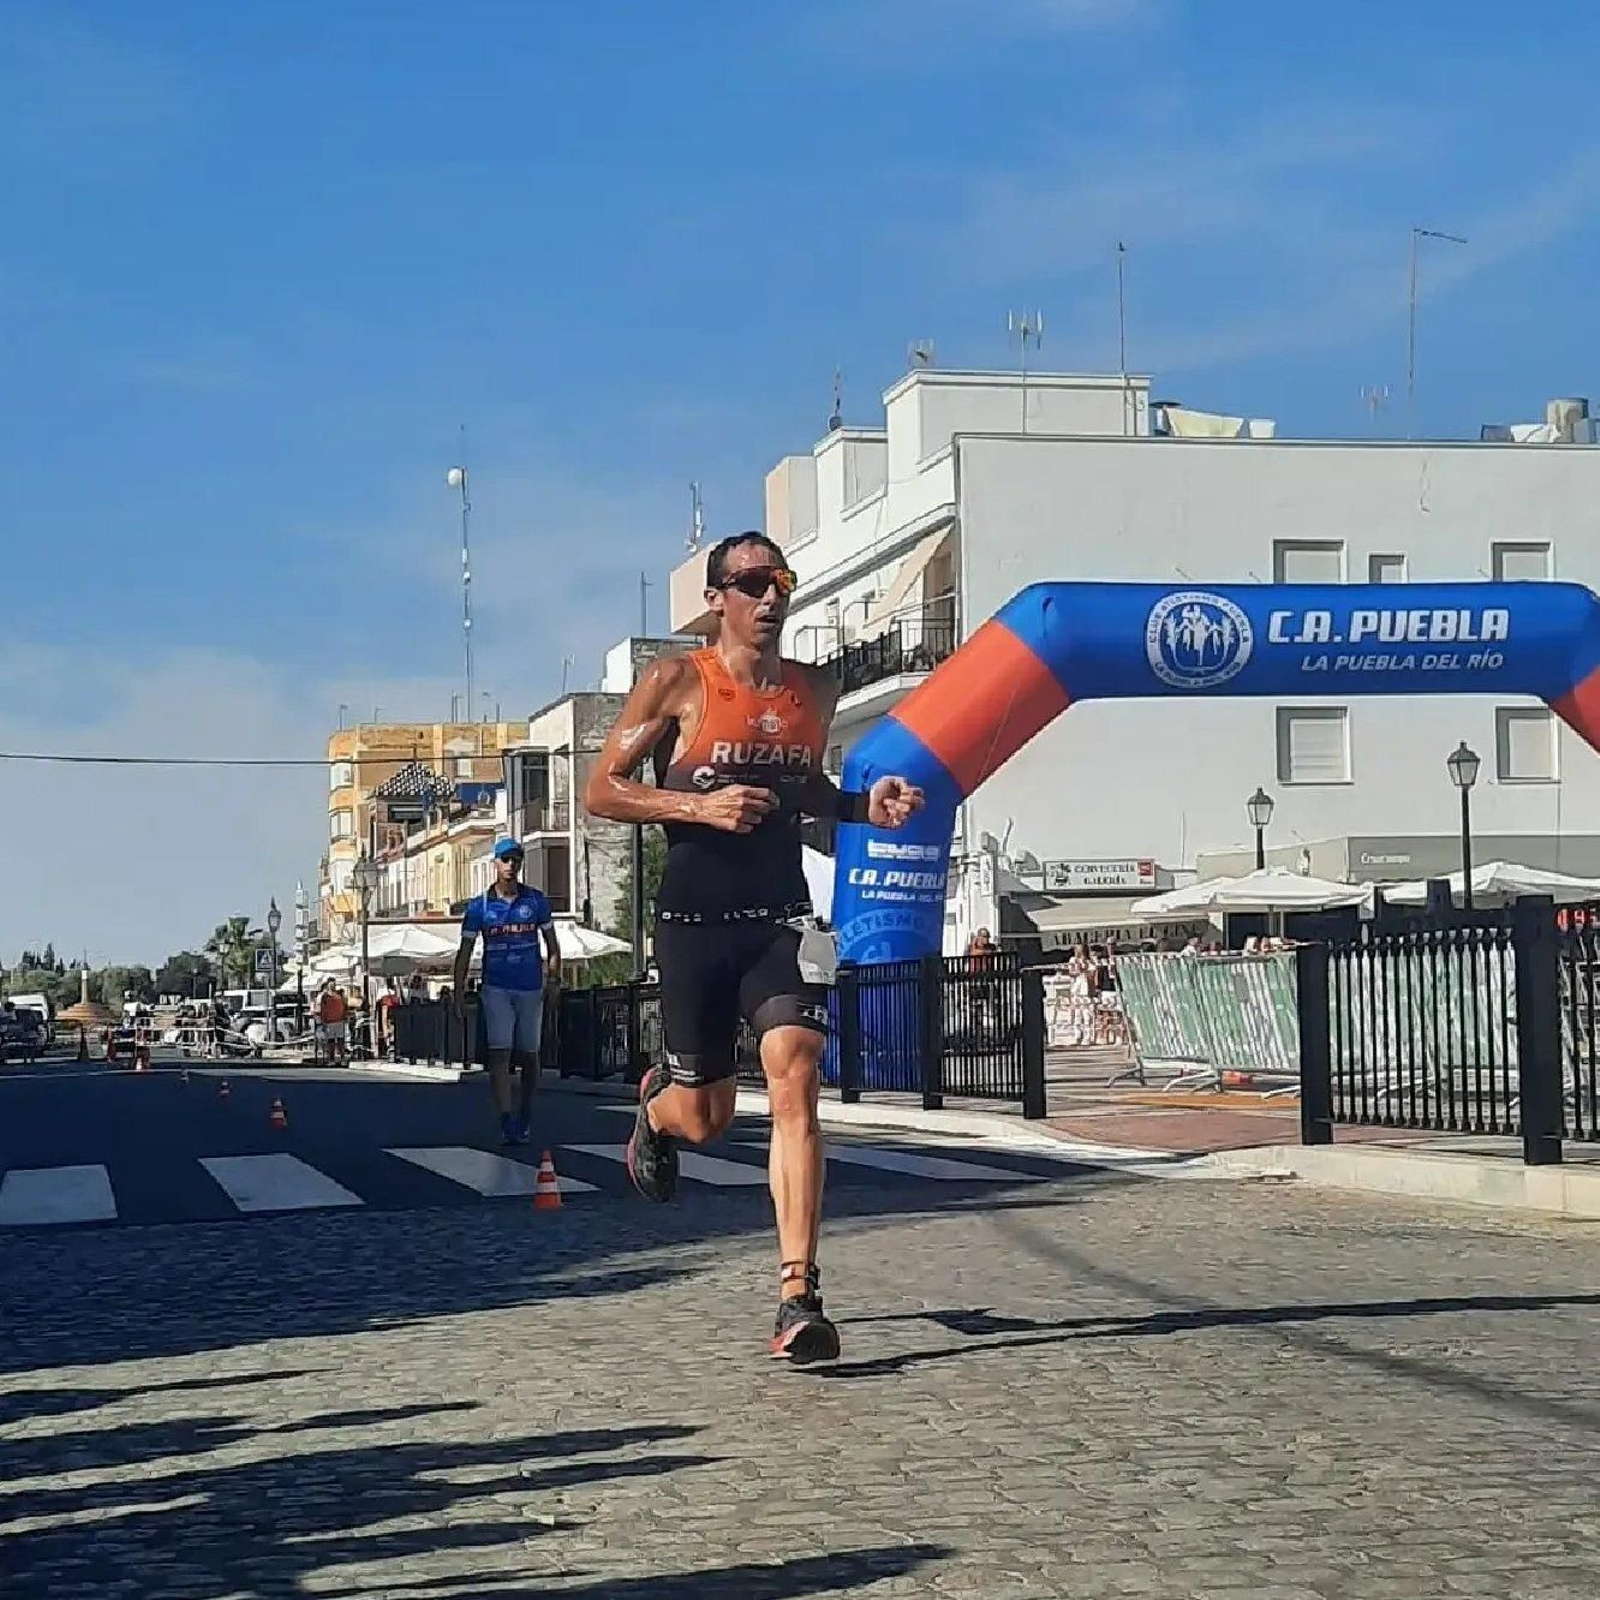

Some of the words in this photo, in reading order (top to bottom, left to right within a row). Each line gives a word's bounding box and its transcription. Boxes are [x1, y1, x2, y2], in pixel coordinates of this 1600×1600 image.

[1268, 610, 1342, 643] C.A.
[1350, 609, 1510, 643] PUEBLA
[1302, 655, 1328, 671] LA
[1334, 655, 1415, 671] PUEBLA
[1421, 654, 1462, 670] DEL
[1467, 647, 1504, 669] RÍO
[711, 741, 811, 766] RUZAFA
